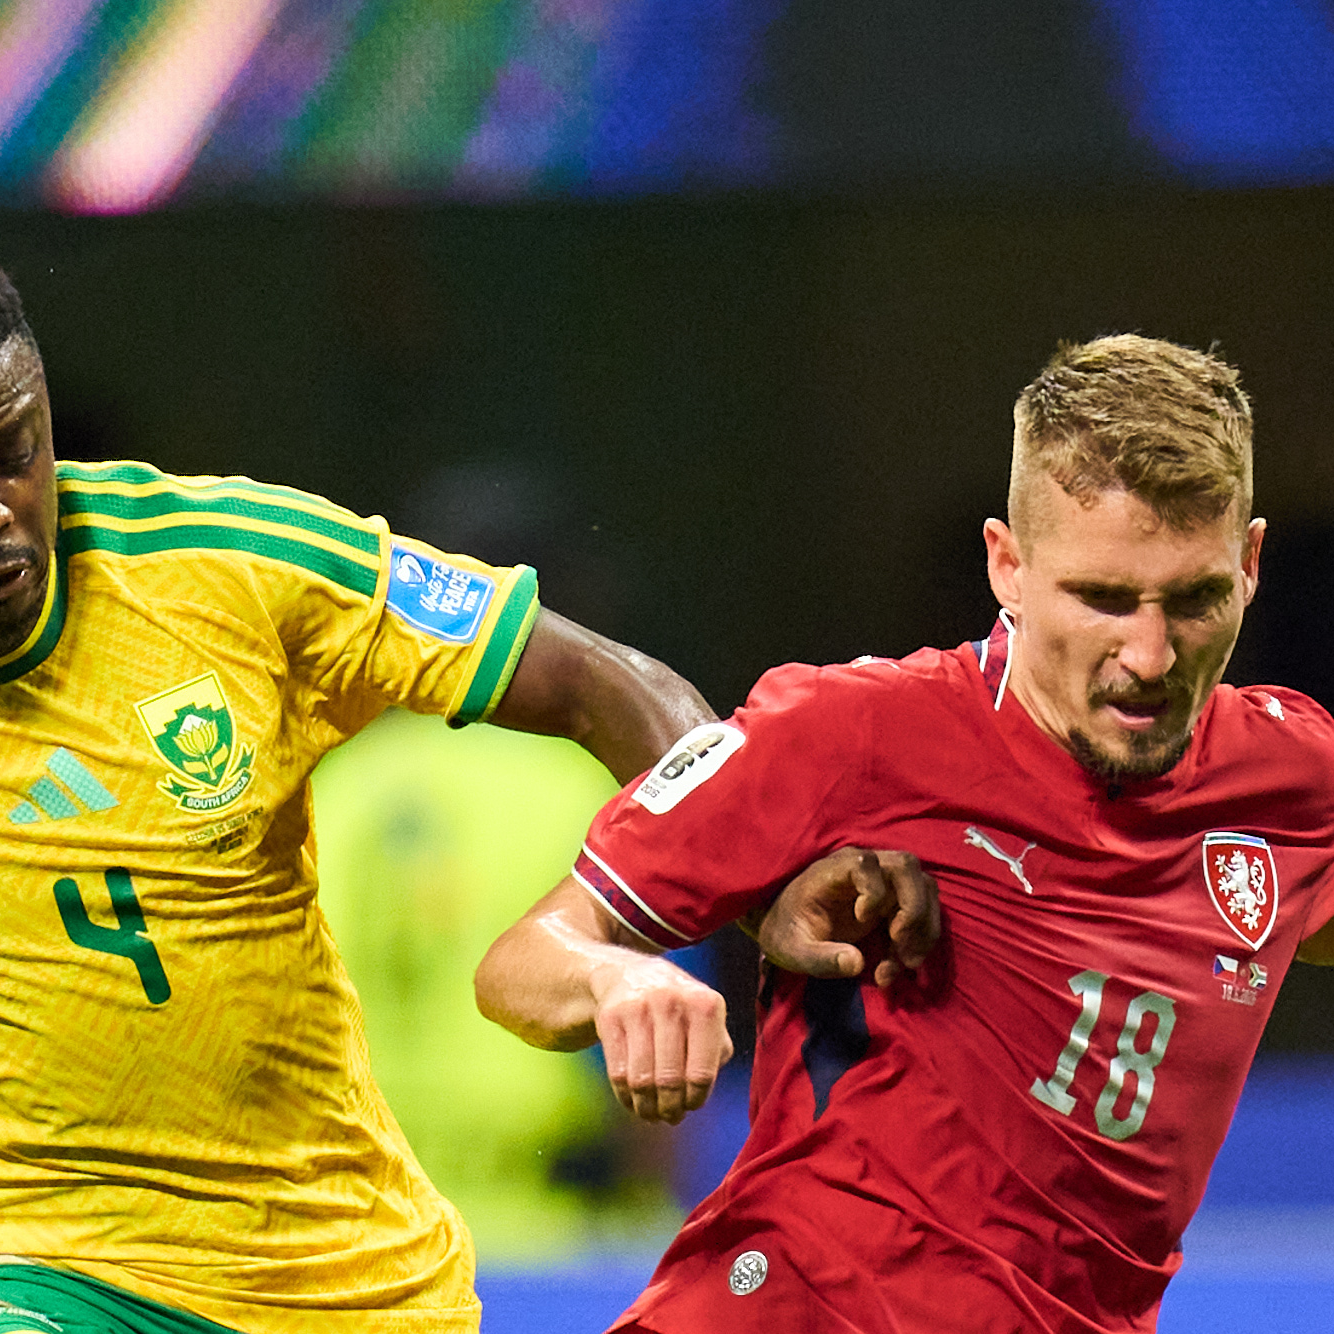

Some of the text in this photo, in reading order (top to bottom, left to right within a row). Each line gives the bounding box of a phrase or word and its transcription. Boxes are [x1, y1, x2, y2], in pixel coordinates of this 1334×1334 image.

[438, 569, 472, 616] PEACE
[186, 776, 249, 809] SOUTH AFRICA
[53, 866, 172, 1005] 4
[1029, 969, 1177, 1141] 18
